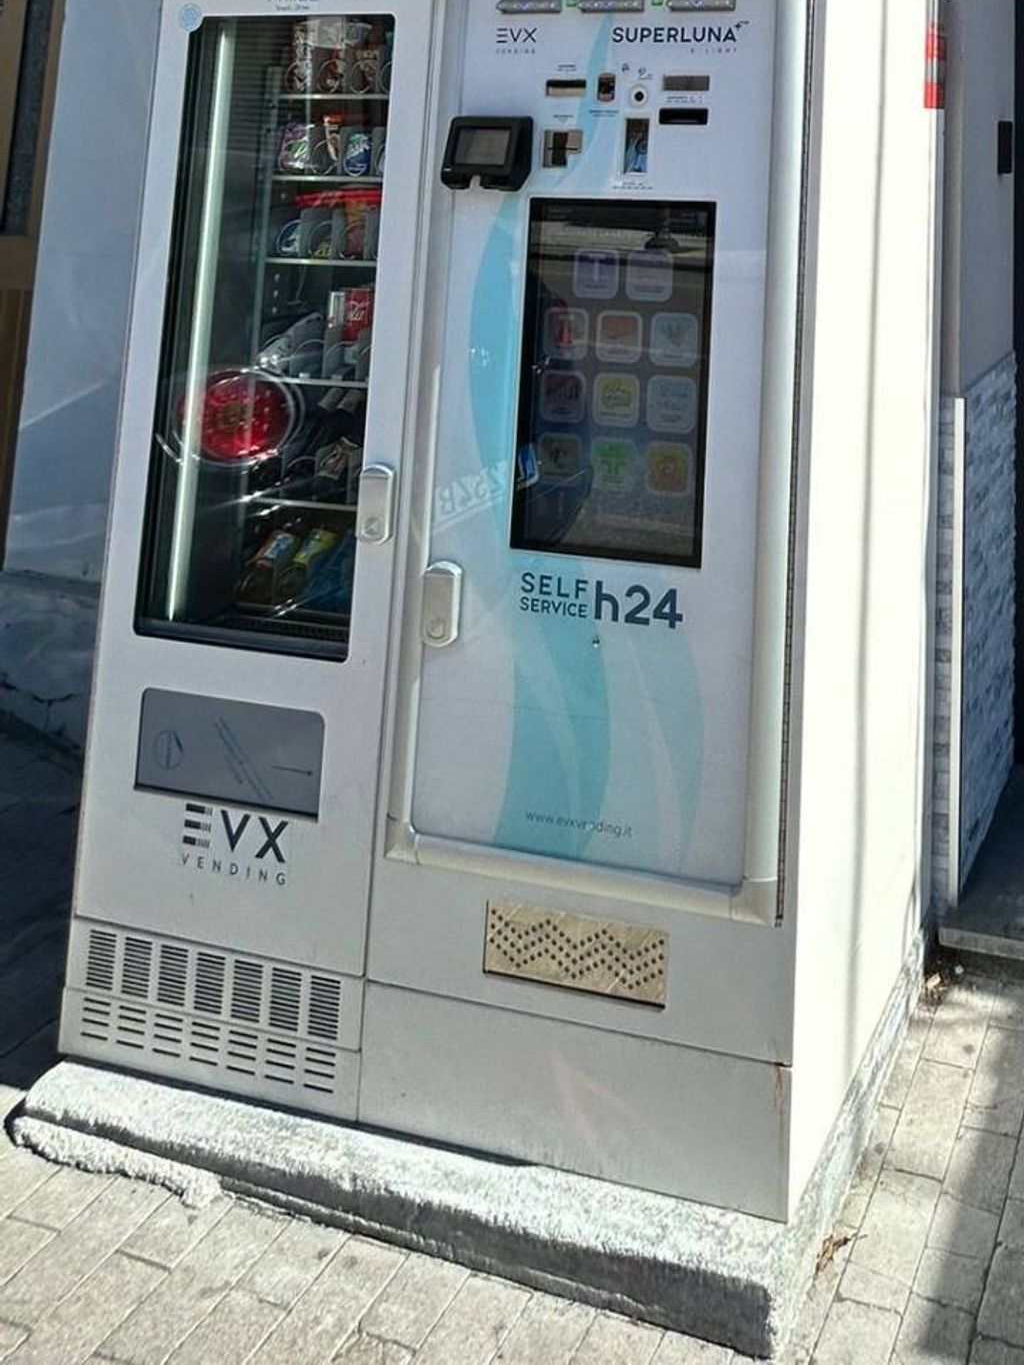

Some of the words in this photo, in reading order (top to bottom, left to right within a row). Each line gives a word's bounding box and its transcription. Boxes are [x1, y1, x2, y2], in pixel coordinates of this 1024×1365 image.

[496, 27, 537, 43] EVX
[612, 26, 736, 43] SUPERLUNA
[521, 572, 589, 599] SELF
[519, 596, 588, 619] SERVICE
[594, 580, 684, 629] h24
[182, 802, 289, 864] EVX
[181, 853, 287, 886] VENDING
